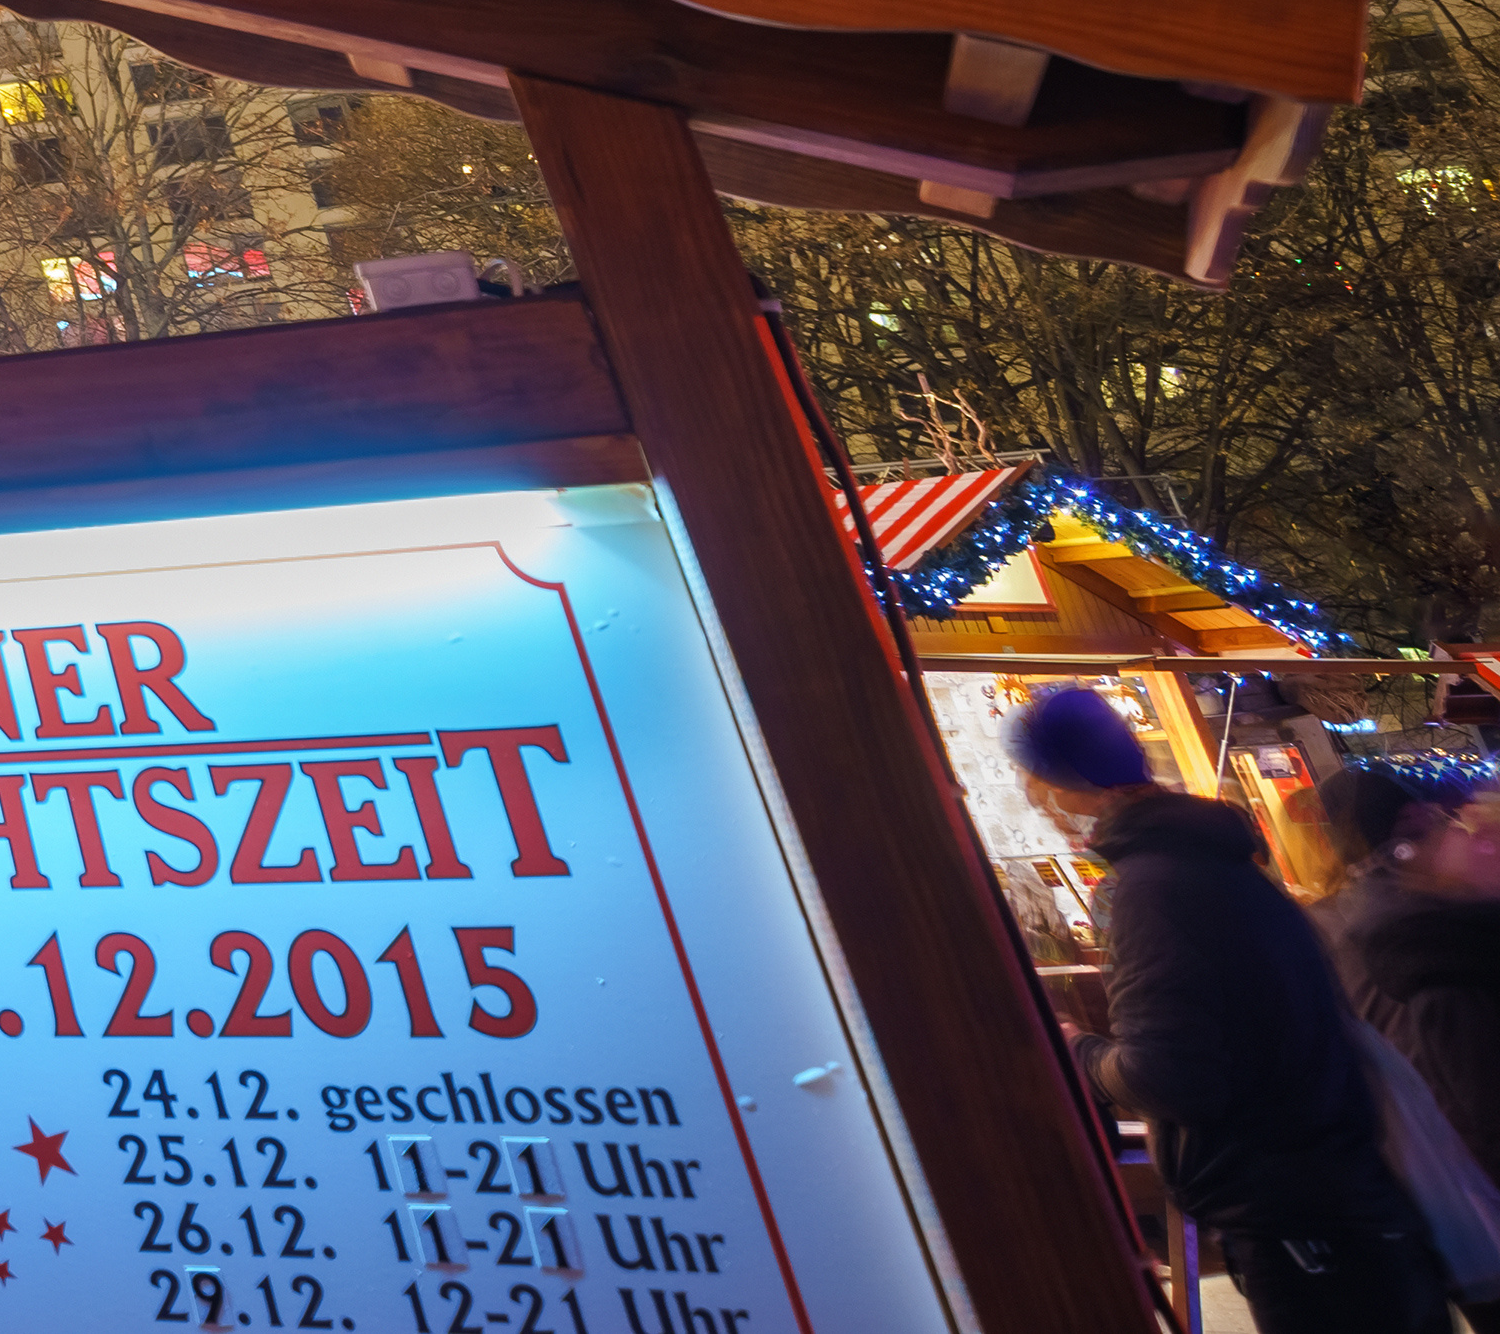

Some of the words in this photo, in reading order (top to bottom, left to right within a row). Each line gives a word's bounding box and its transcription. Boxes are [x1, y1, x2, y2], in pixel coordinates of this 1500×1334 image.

[103, 1069, 298, 1120] 24.12.
[321, 1073, 681, 1132] geschlossen
[118, 1135, 318, 1189] 25.12.
[365, 1139, 556, 1199] 11-21
[574, 1143, 701, 1199] Uhr
[134, 1201, 336, 1260] 26.12.
[384, 1209, 572, 1271] 11-21
[597, 1215, 725, 1274] Uhr
[150, 1269, 355, 1331] 29.12.
[404, 1281, 588, 1334] 12-21
[619, 1289, 750, 1334] Uhr
